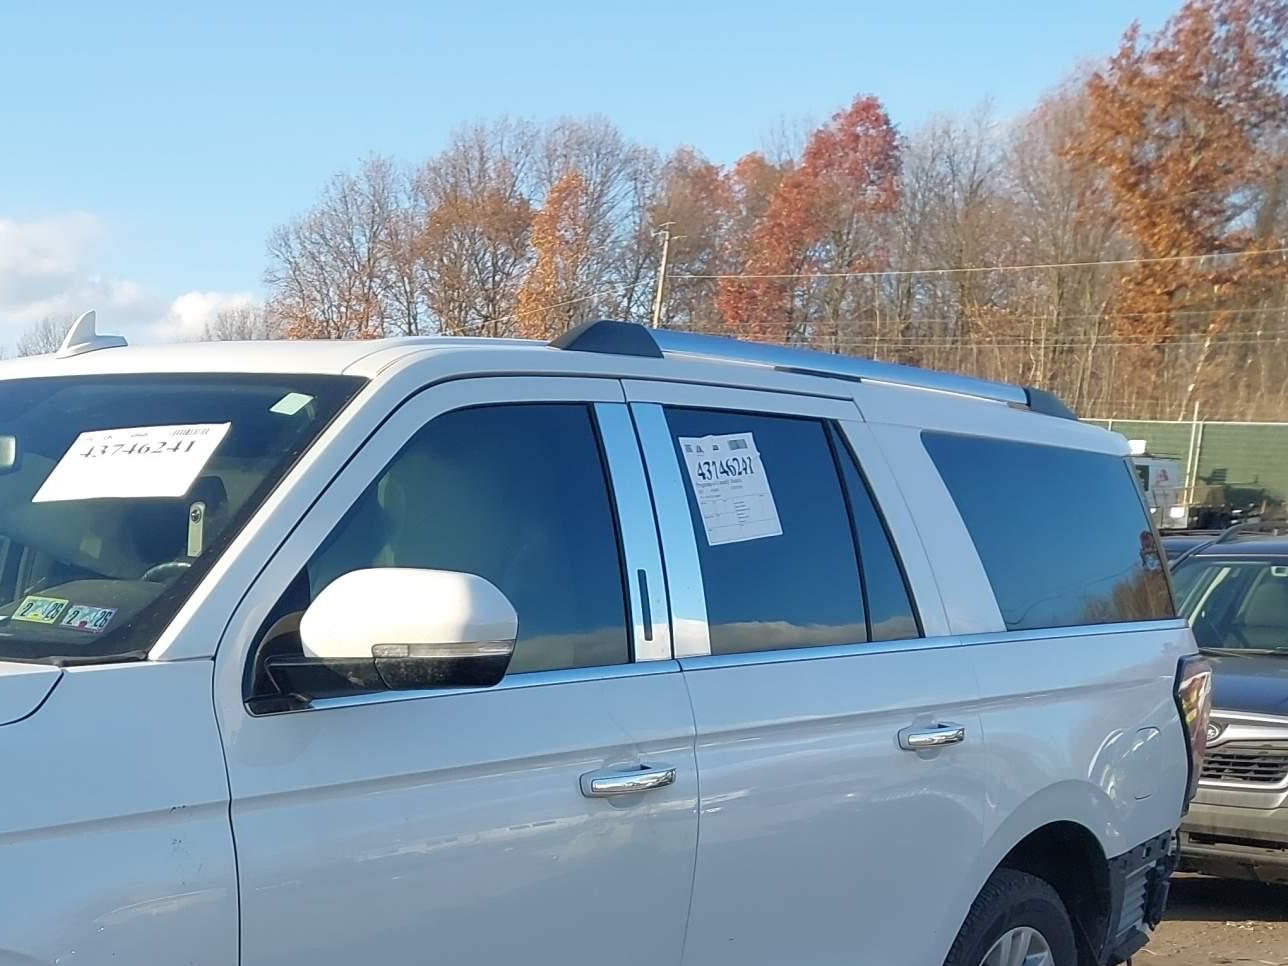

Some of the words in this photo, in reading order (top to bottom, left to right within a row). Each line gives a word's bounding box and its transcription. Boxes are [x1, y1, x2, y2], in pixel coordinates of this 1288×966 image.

[79, 439, 198, 460] 43746241
[696, 456, 755, 481] 43746241
[20, 602, 34, 617] 2
[66, 610, 80, 625] 2
